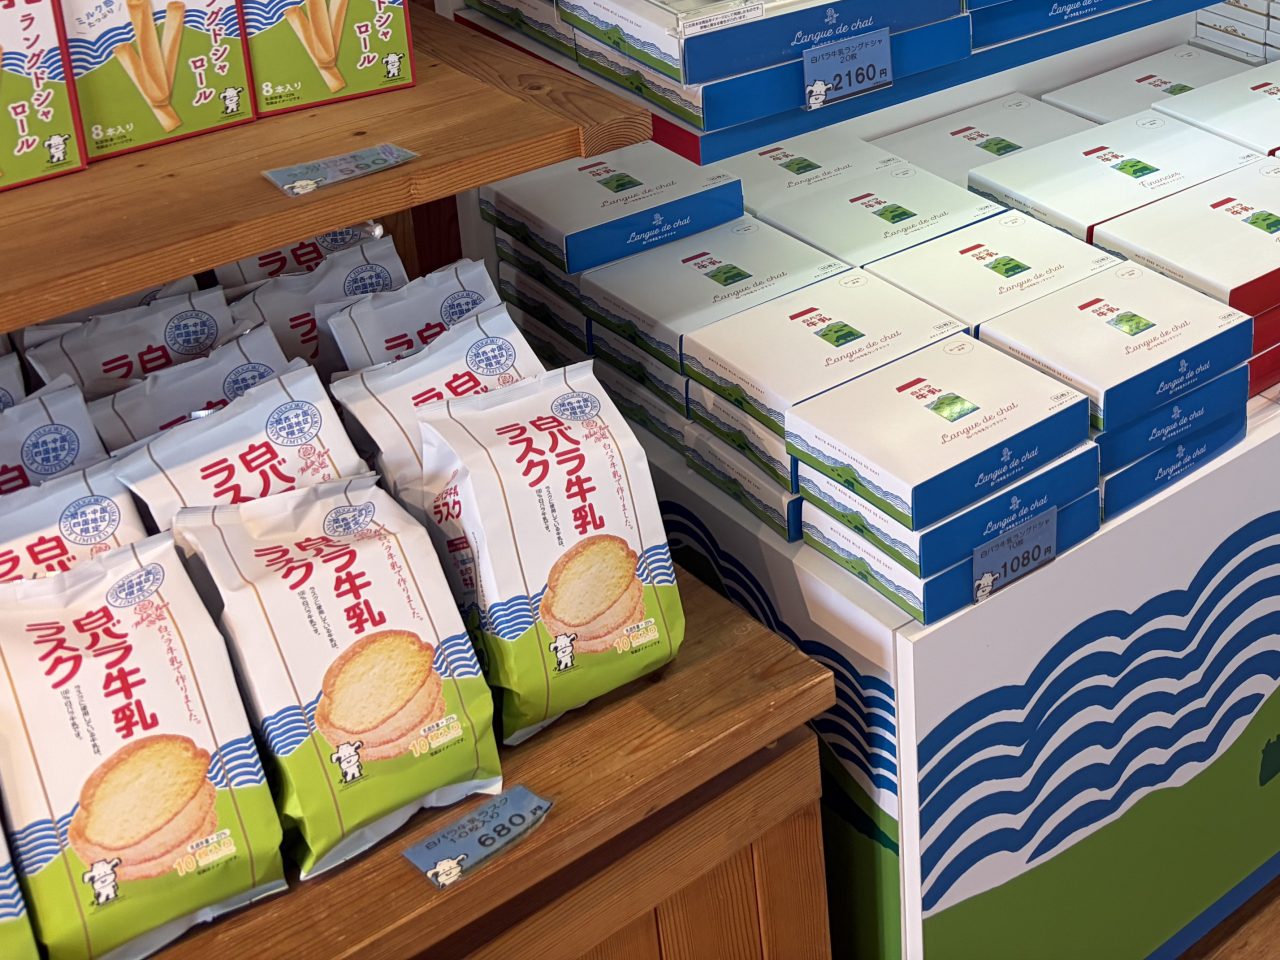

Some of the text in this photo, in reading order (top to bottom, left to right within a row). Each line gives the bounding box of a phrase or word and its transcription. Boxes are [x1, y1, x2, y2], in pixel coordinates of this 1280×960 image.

[87, 7, 115, 30] たっぷり
[791, 16, 874, 47] Langue de chat
[355, 22, 378, 69] ロール
[810, 39, 883, 64] 白バラ牛乳ラングドシャ
[19, 14, 54, 123] ラングドシャ
[191, 57, 215, 107] ロール
[833, 64, 887, 91] 2160 円
[262, 81, 302, 96] 8本入り
[10, 100, 38, 157] ロール
[91, 121, 135, 140] 8本入り
[627, 216, 691, 244] Langue de chat
[286, 426, 306, 438] 限定
[495, 422, 550, 488] ラスク
[974, 445, 1040, 488] Langue de chat
[529, 415, 606, 536] 白バラ牛乳
[433, 499, 462, 525] ラスク
[1000, 544, 1052, 578] 1080 円
[25, 620, 83, 691] ラスク
[72, 604, 159, 740] 白バラ牛乳
[477, 813, 526, 848] 680
